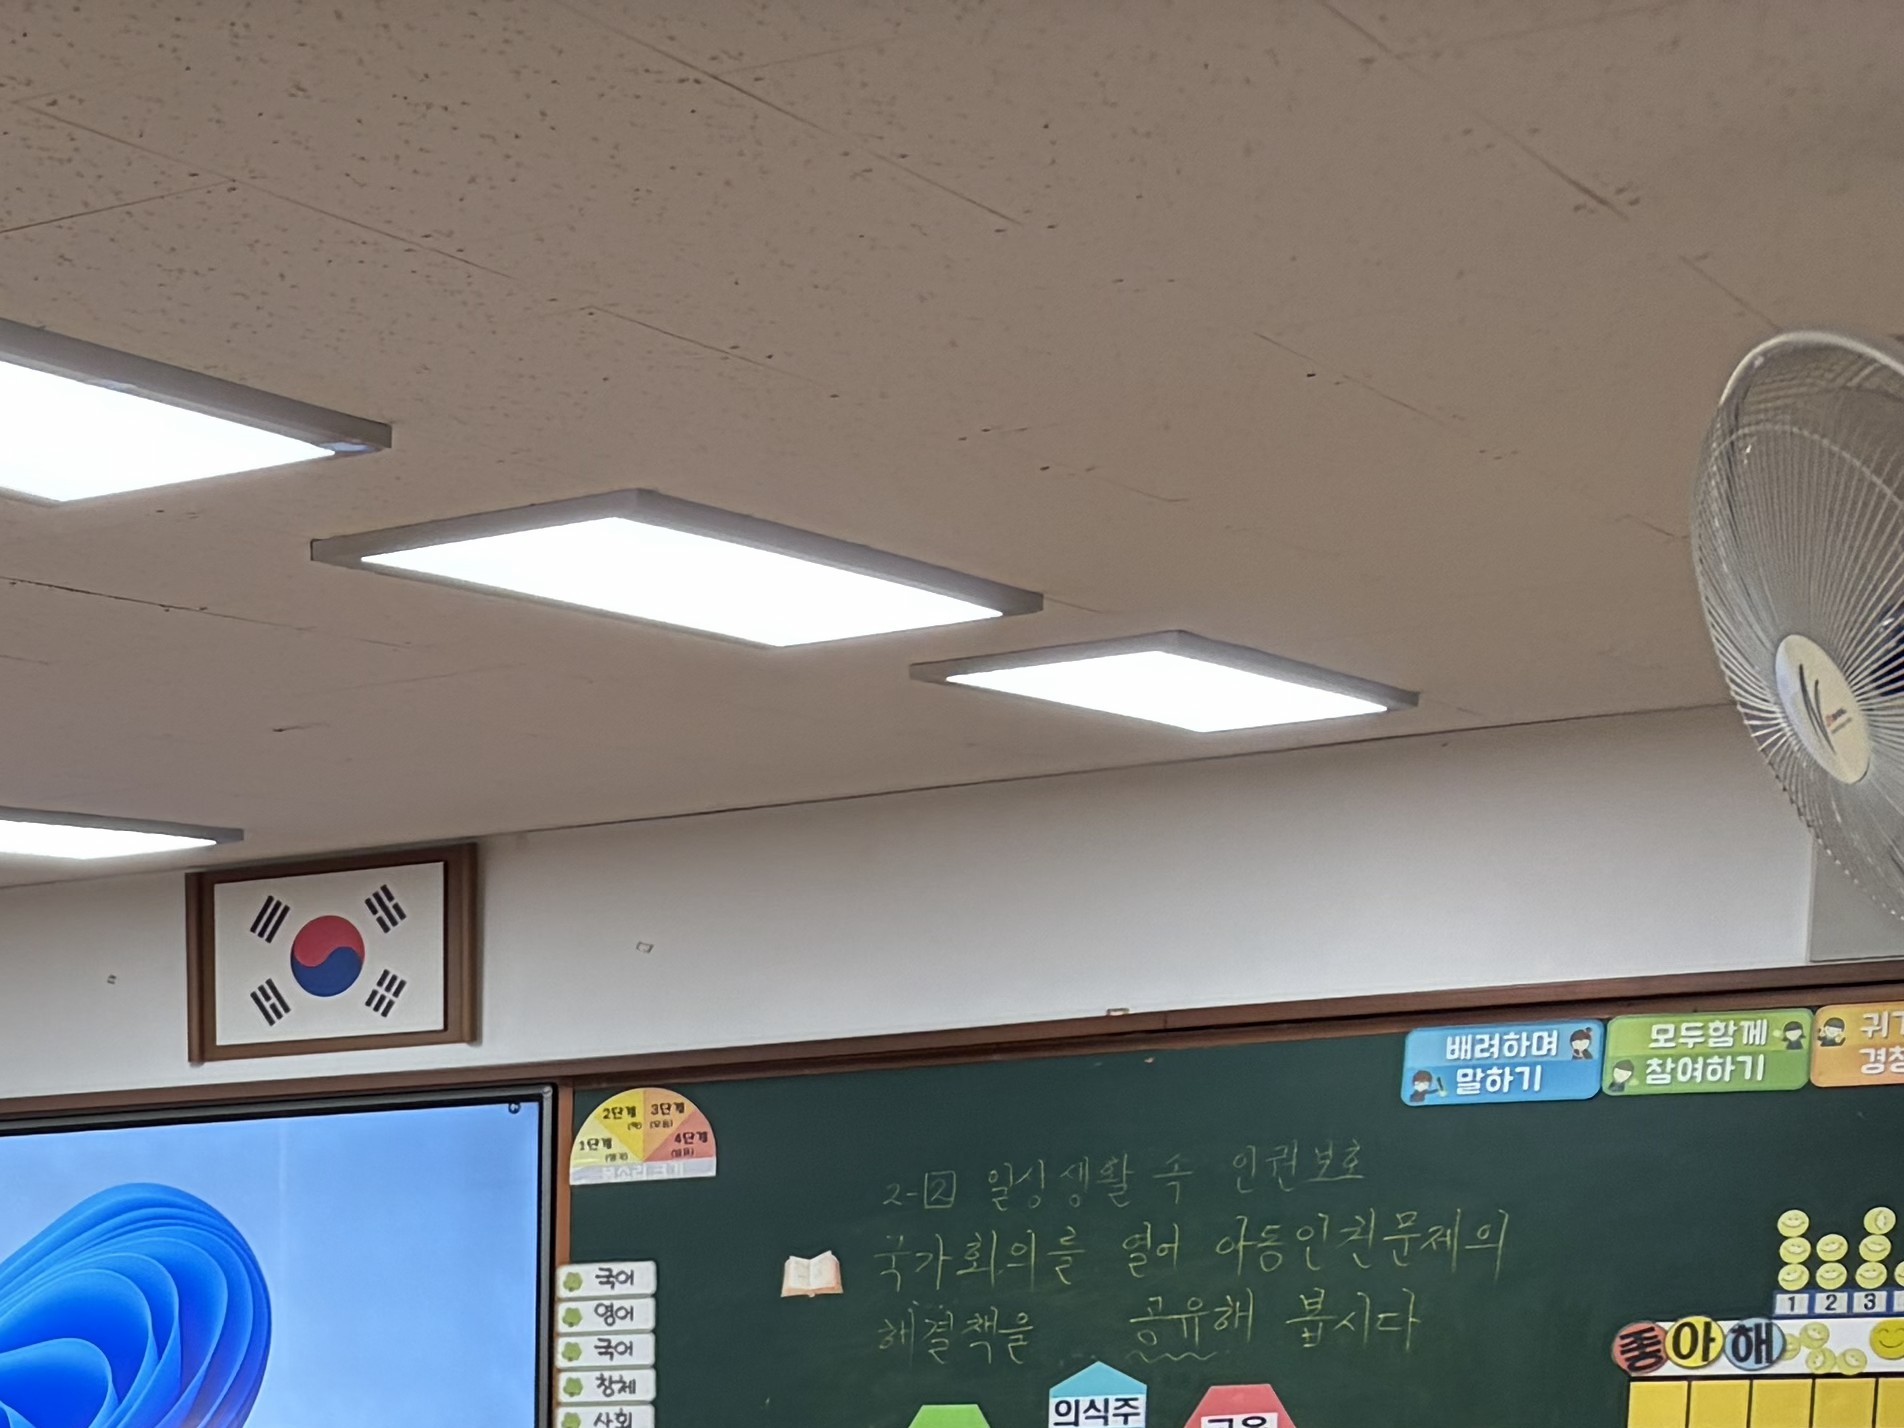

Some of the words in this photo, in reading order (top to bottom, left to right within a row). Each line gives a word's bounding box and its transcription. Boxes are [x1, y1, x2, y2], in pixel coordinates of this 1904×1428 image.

[1445, 1030, 1558, 1061] 배려하며
[1649, 1019, 1769, 1051] 모두함께
[1455, 1065, 1543, 1096] 말하기
[1644, 1053, 1766, 1086] 참여하기
[603, 1106, 637, 1119] 2단계
[651, 1102, 685, 1116] 3단계
[579, 1137, 613, 1151] 1단계
[674, 1131, 708, 1145] 4단계
[987, 1152, 1134, 1212] 일상생활
[1151, 1153, 1194, 1206] 속
[872, 1226, 1086, 1292] 국가회의를
[1122, 1220, 1180, 1278] 열어
[594, 1267, 635, 1289] 국어
[594, 1303, 635, 1327] 영어
[1787, 1297, 1798, 1312] 1
[1825, 1295, 1838, 1311] 2
[1863, 1294, 1876, 1310] 3
[878, 1309, 1034, 1365] 해결책을
[1285, 1287, 1424, 1351] 봅시다
[594, 1338, 634, 1359] 국어
[595, 1374, 637, 1397] 창체
[1053, 1397, 1142, 1427] 의식주
